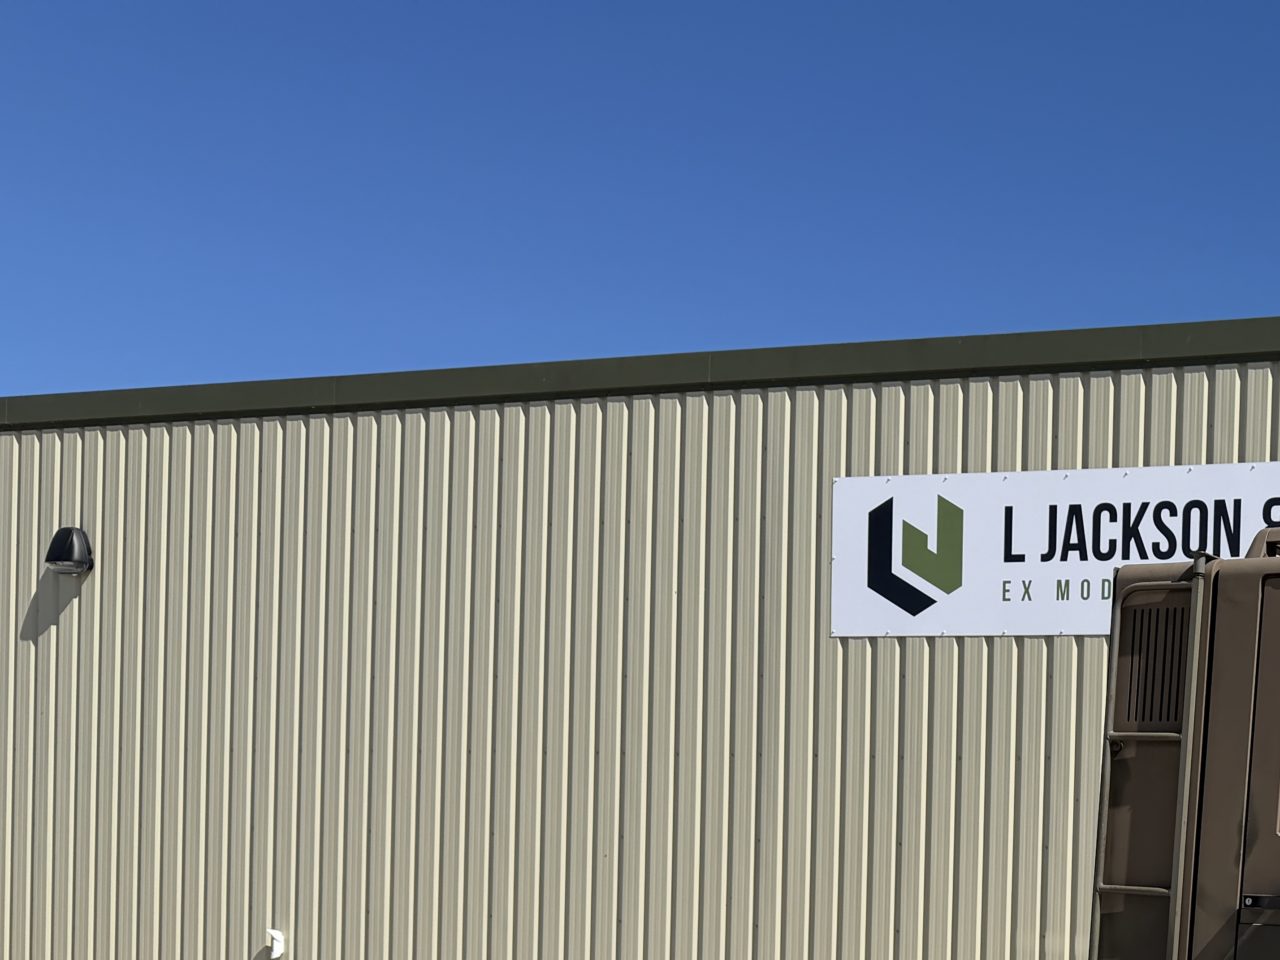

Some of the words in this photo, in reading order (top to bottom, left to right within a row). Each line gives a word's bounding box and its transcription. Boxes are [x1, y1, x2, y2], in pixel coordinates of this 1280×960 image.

[1003, 505, 1026, 563] L
[1040, 499, 1242, 562] JACKSON
[1002, 580, 1033, 602] EX
[1056, 578, 1113, 602] MOD
